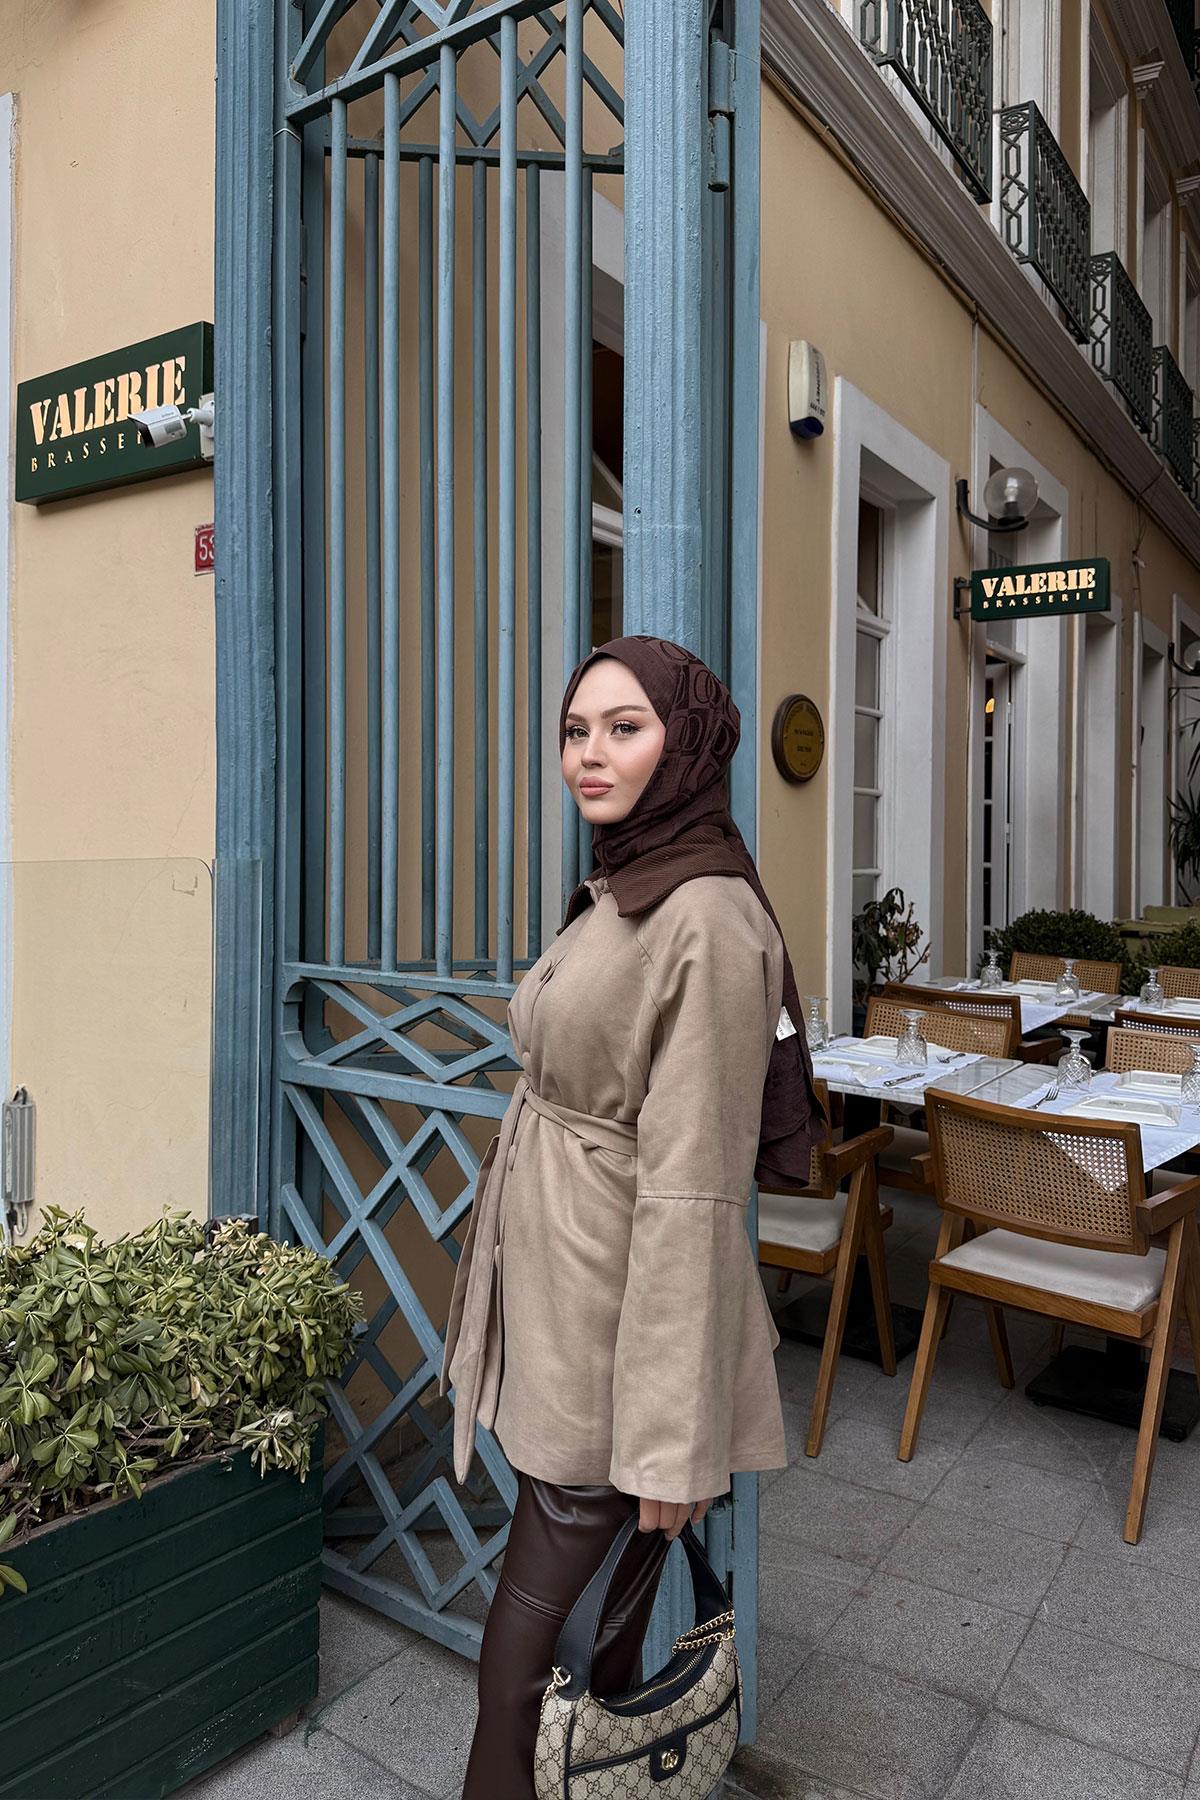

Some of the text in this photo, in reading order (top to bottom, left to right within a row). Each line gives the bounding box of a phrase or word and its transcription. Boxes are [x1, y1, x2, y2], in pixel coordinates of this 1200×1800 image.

[30, 355, 186, 446] VALERIE
[981, 567, 1096, 599] VALERIE
[983, 591, 1094, 609] BRASSERIE
